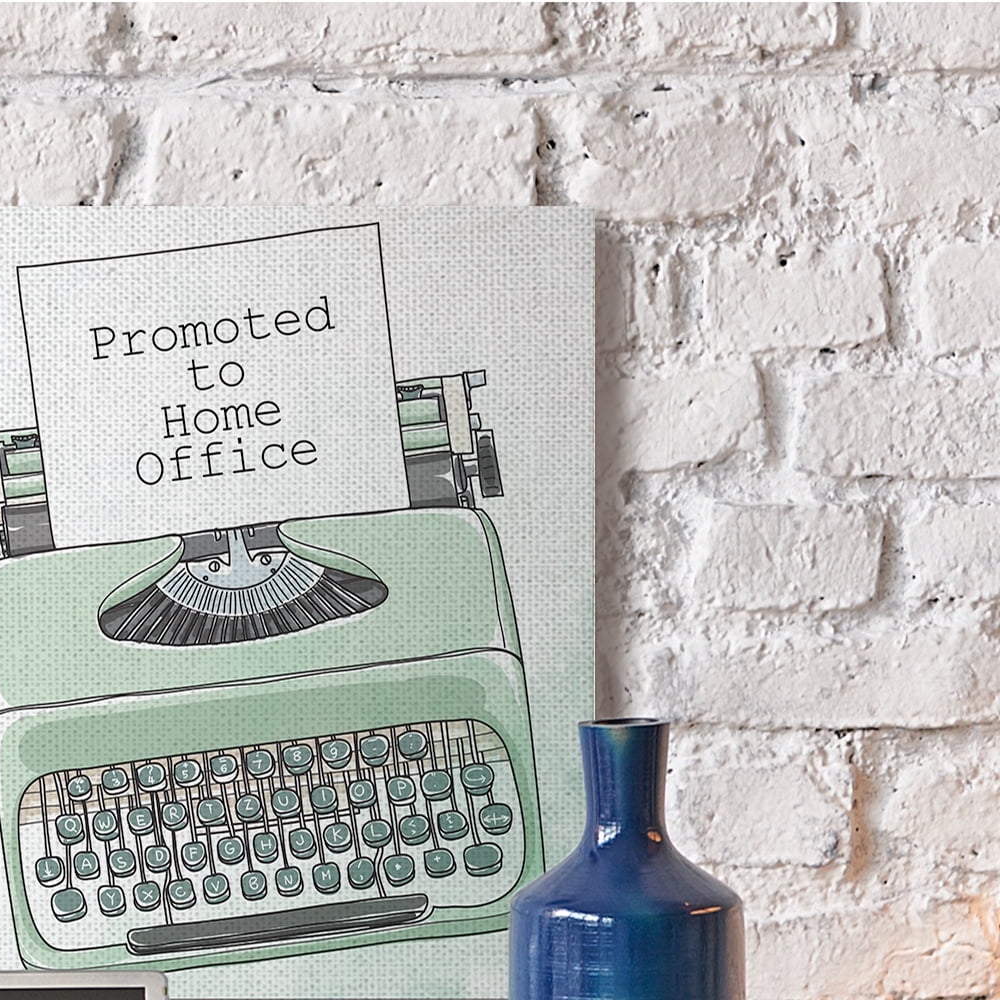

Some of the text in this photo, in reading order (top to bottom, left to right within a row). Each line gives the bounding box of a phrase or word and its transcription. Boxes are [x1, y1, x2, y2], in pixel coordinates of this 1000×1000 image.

[90, 296, 335, 360] Promoted
[188, 360, 244, 390] to
[161, 401, 281, 438] Home
[136, 437, 317, 485] Office
